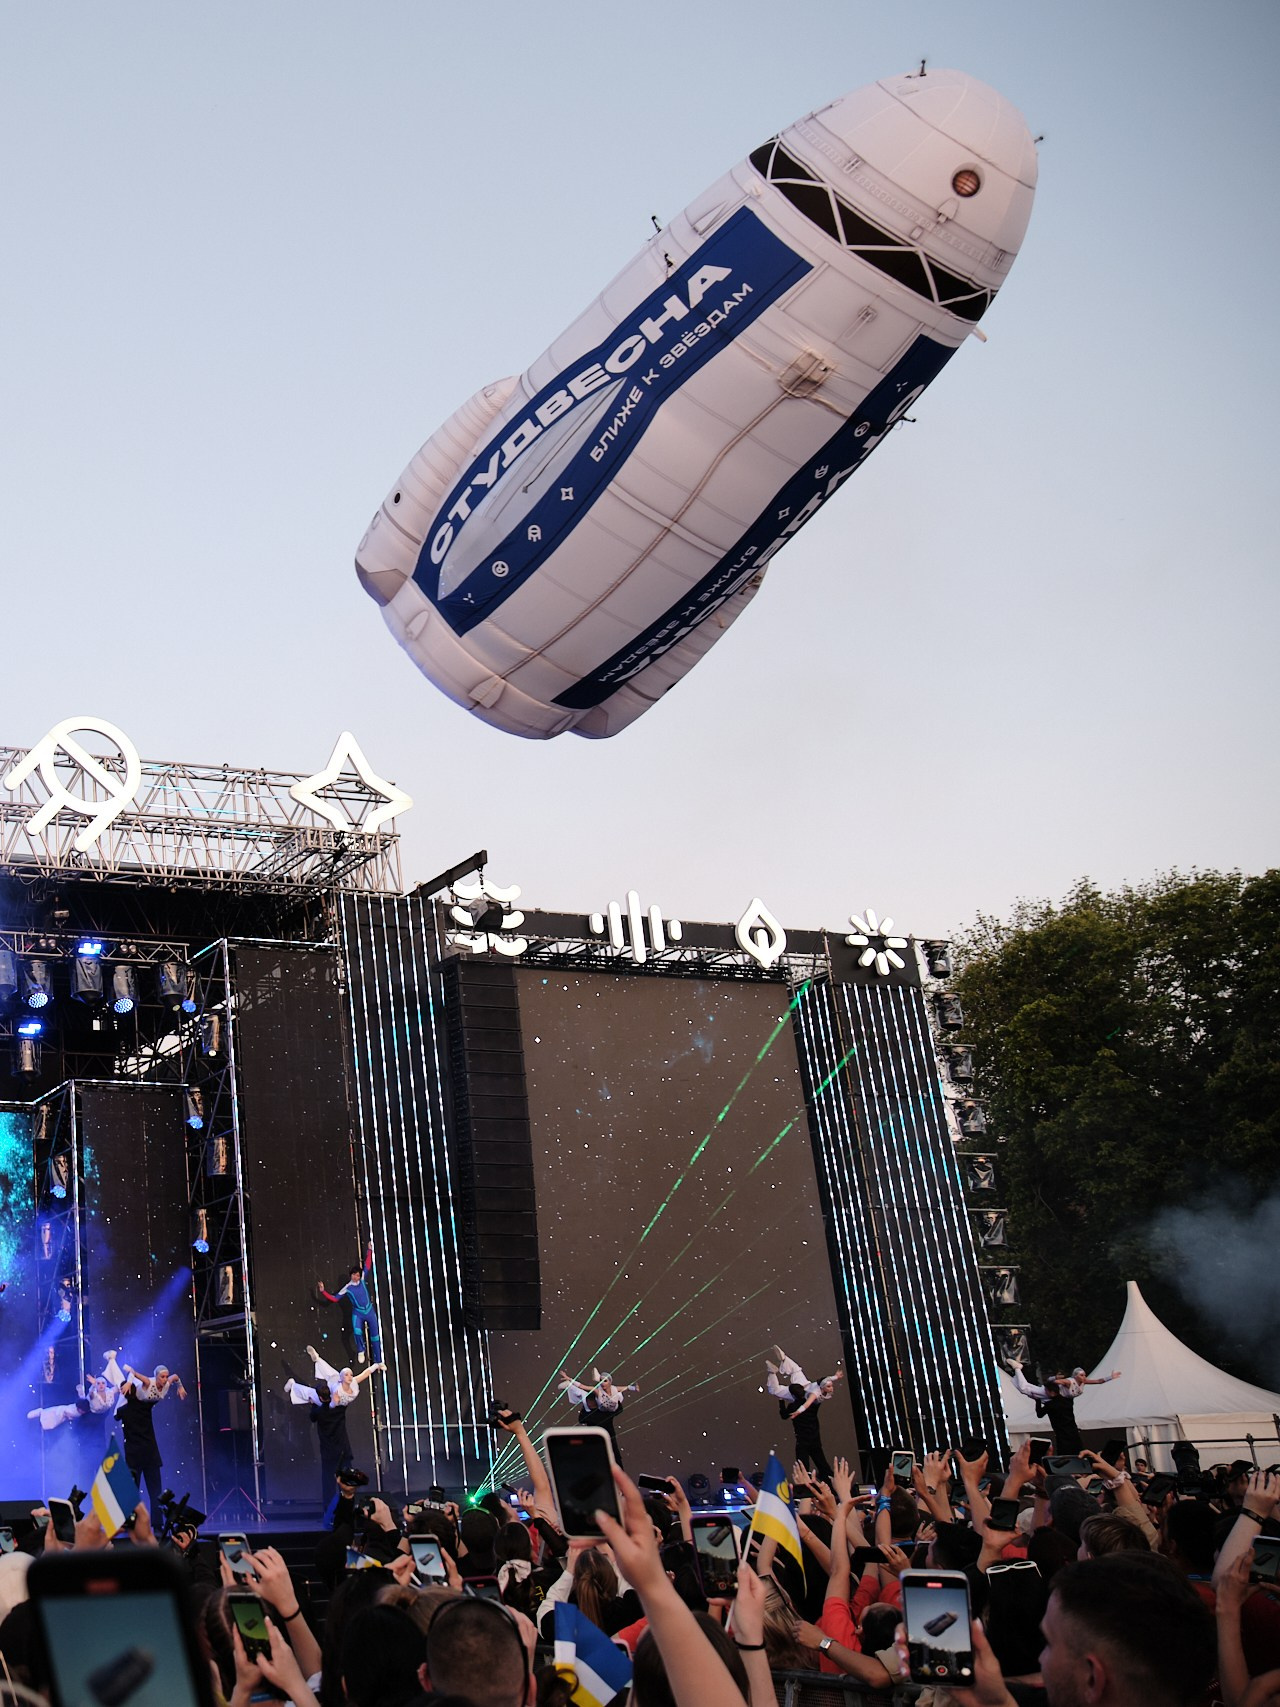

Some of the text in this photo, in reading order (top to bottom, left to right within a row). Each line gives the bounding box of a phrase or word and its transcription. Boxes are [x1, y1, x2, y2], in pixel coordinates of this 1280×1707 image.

[430, 264, 733, 565] СТУДВЕСНА
[589, 282, 754, 462] БЛИЖЕ К ЗВЁЗДАМ
[681, 606, 696, 616] К
[698, 546, 758, 602] БЛИЖЕ
